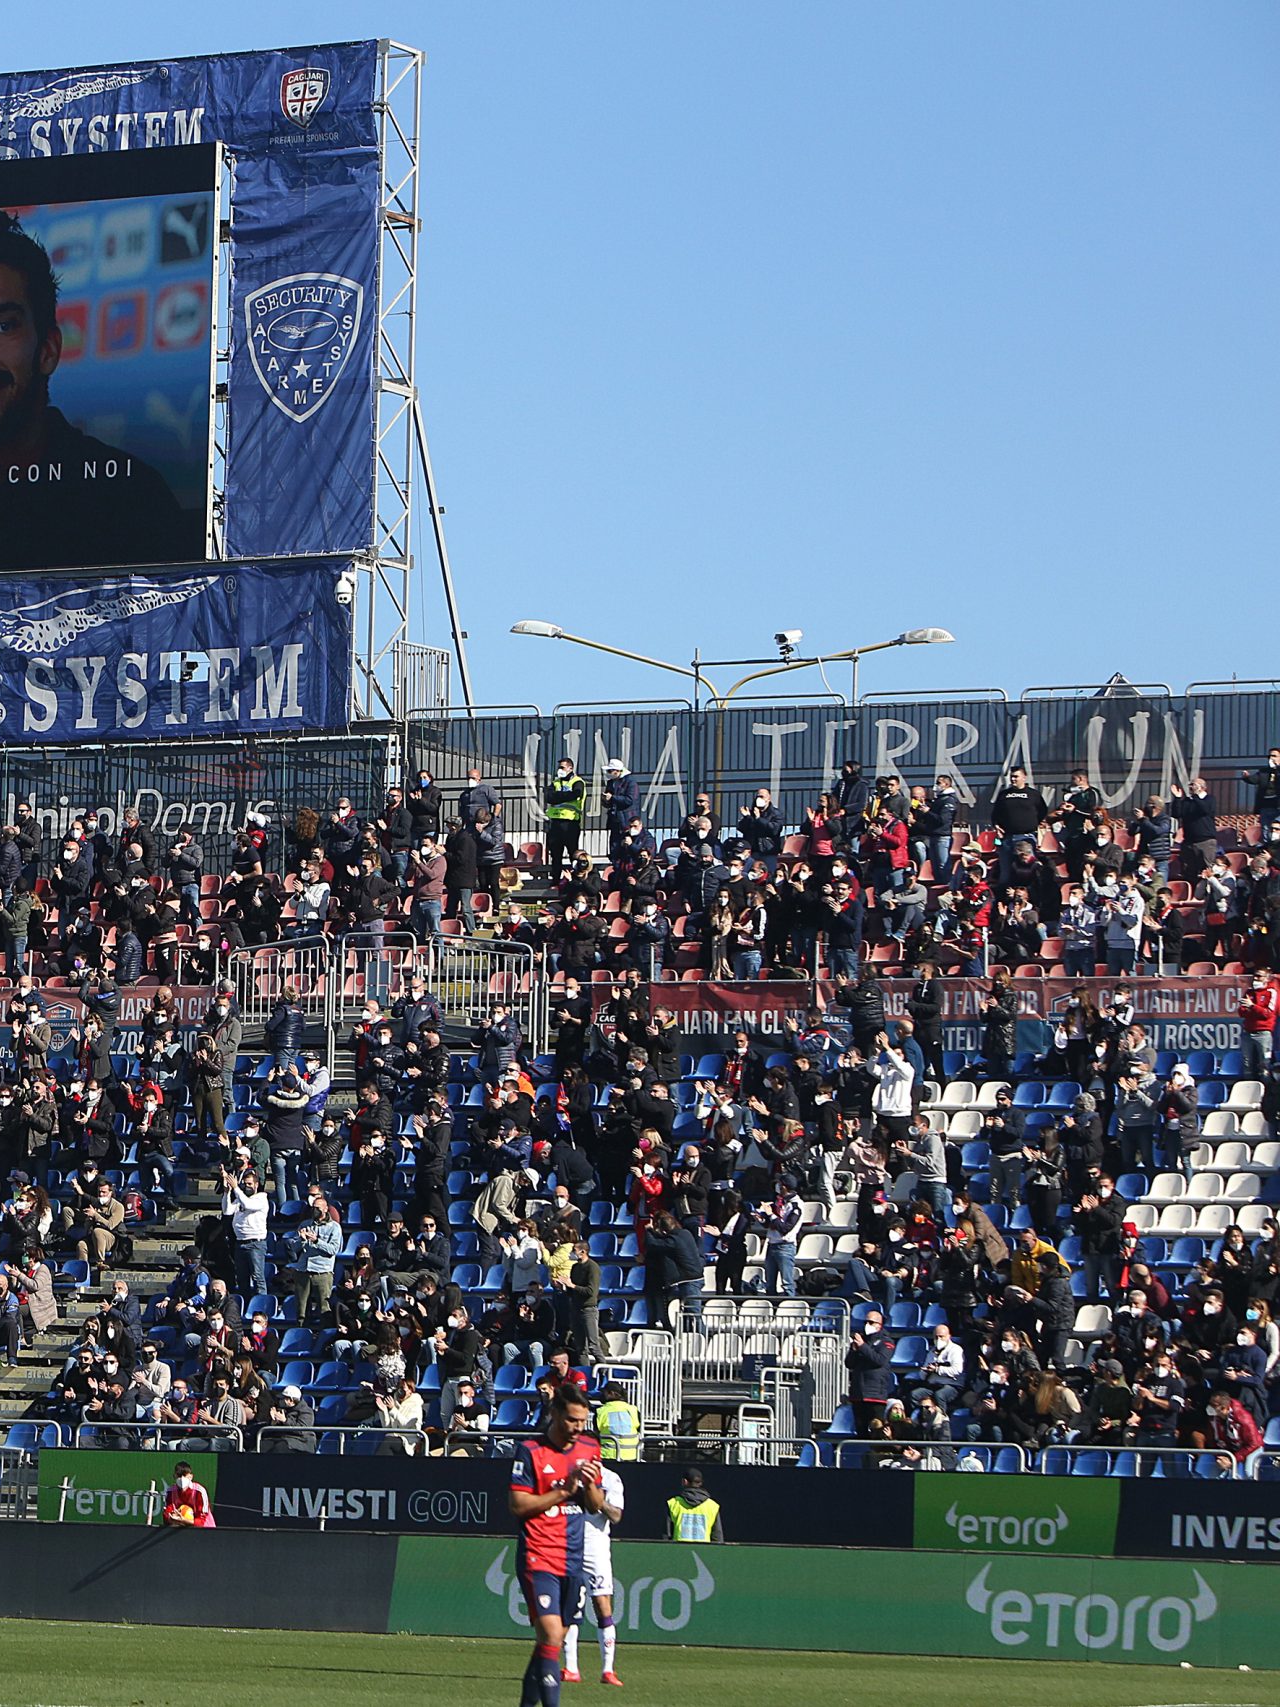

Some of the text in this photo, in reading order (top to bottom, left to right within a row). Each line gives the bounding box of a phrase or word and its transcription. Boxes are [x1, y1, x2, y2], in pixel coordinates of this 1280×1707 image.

[288, 72, 325, 84] CAGLIARI
[30, 106, 206, 159] SYSTEM
[269, 132, 340, 145] PREMIUM SPONSOR
[254, 286, 353, 318] SECURITY
[8, 463, 62, 484] CON
[84, 459, 132, 480] NOI
[22, 642, 304, 732] SYSTEM
[1087, 709, 1205, 808] UN
[1184, 988, 1220, 1013] FAN
[723, 1010, 757, 1035] FAN
[261, 1486, 489, 1524] INVESTI CON
